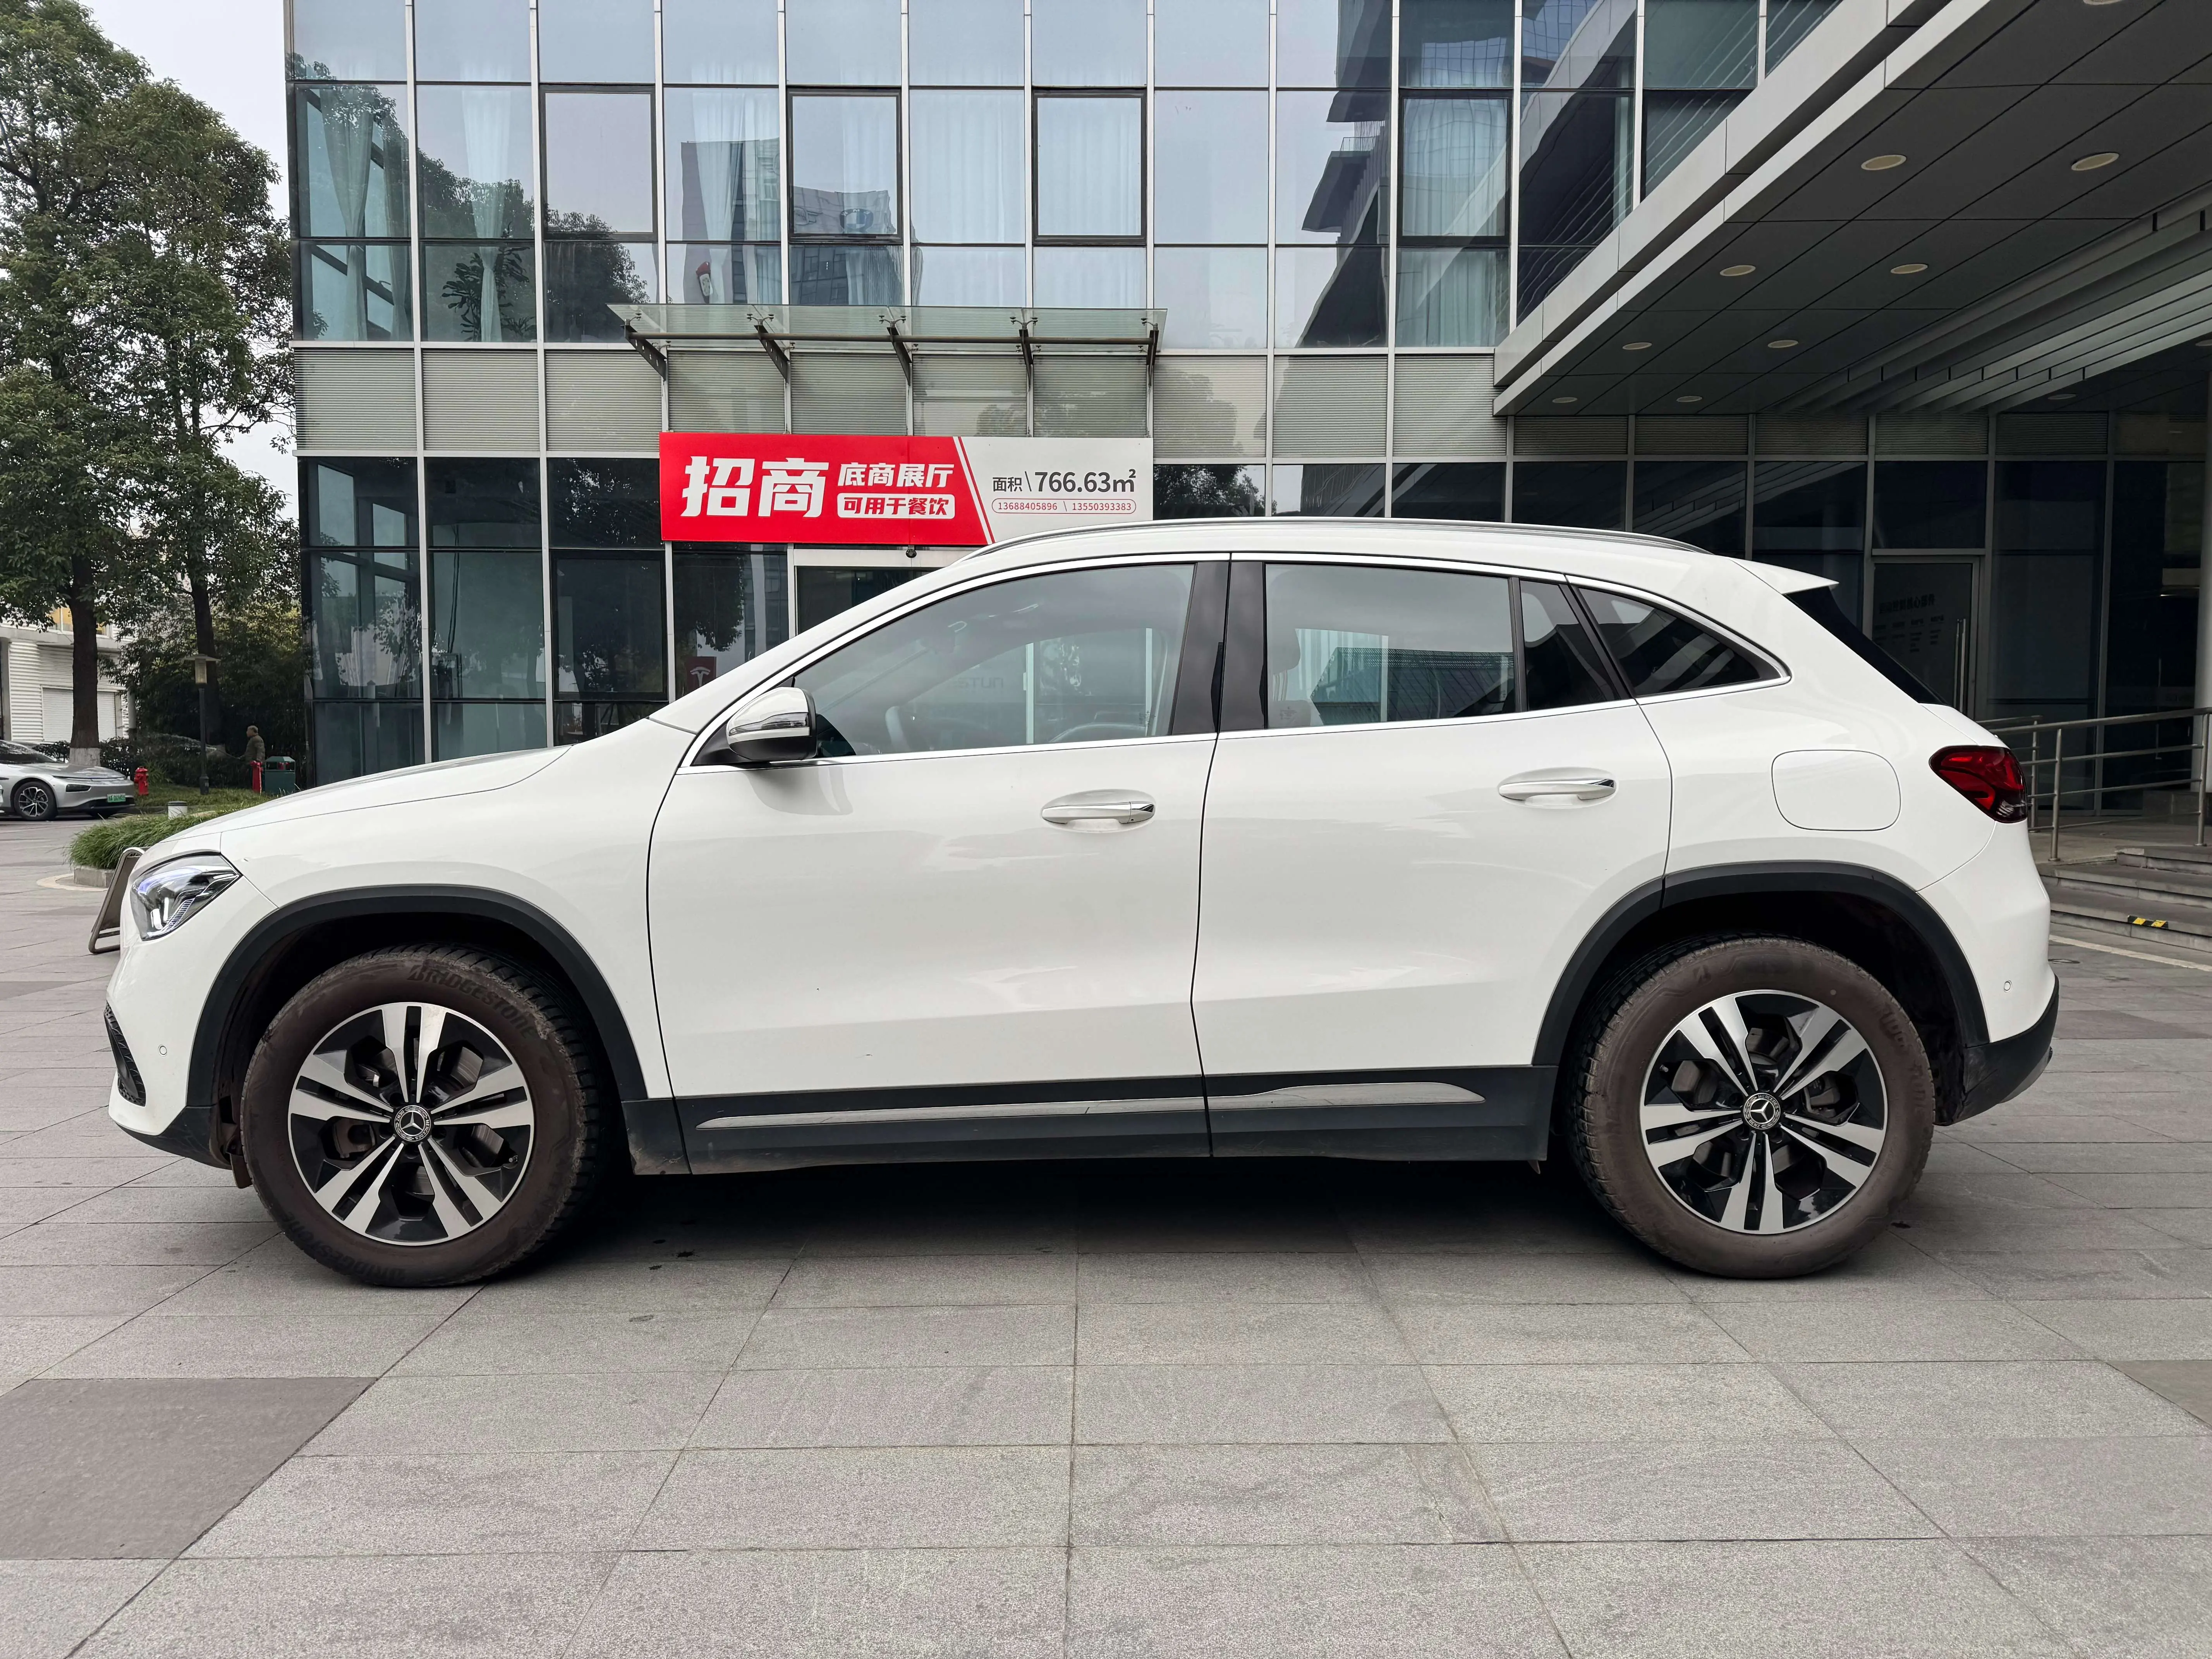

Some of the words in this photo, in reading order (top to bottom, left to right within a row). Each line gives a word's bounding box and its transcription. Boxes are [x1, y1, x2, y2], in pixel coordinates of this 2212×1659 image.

[838, 462, 954, 487] 底商展厅
[993, 476, 1022, 492] 面积
[1035, 469, 1136, 492] 766.63m²
[680, 456, 829, 517] 招商
[844, 497, 949, 515] 可用于餐饮
[998, 502, 1057, 510] 13688405896
[1072, 502, 1131, 511] 13550393383
[407, 961, 534, 1039] BRIDGESTONE
[1758, 1094, 1779, 1109] MERCEDES
[396, 1110, 405, 1121] BENZ
[1748, 1119, 1761, 1128] BENZ
[414, 1120, 430, 1140] MERCEDES
